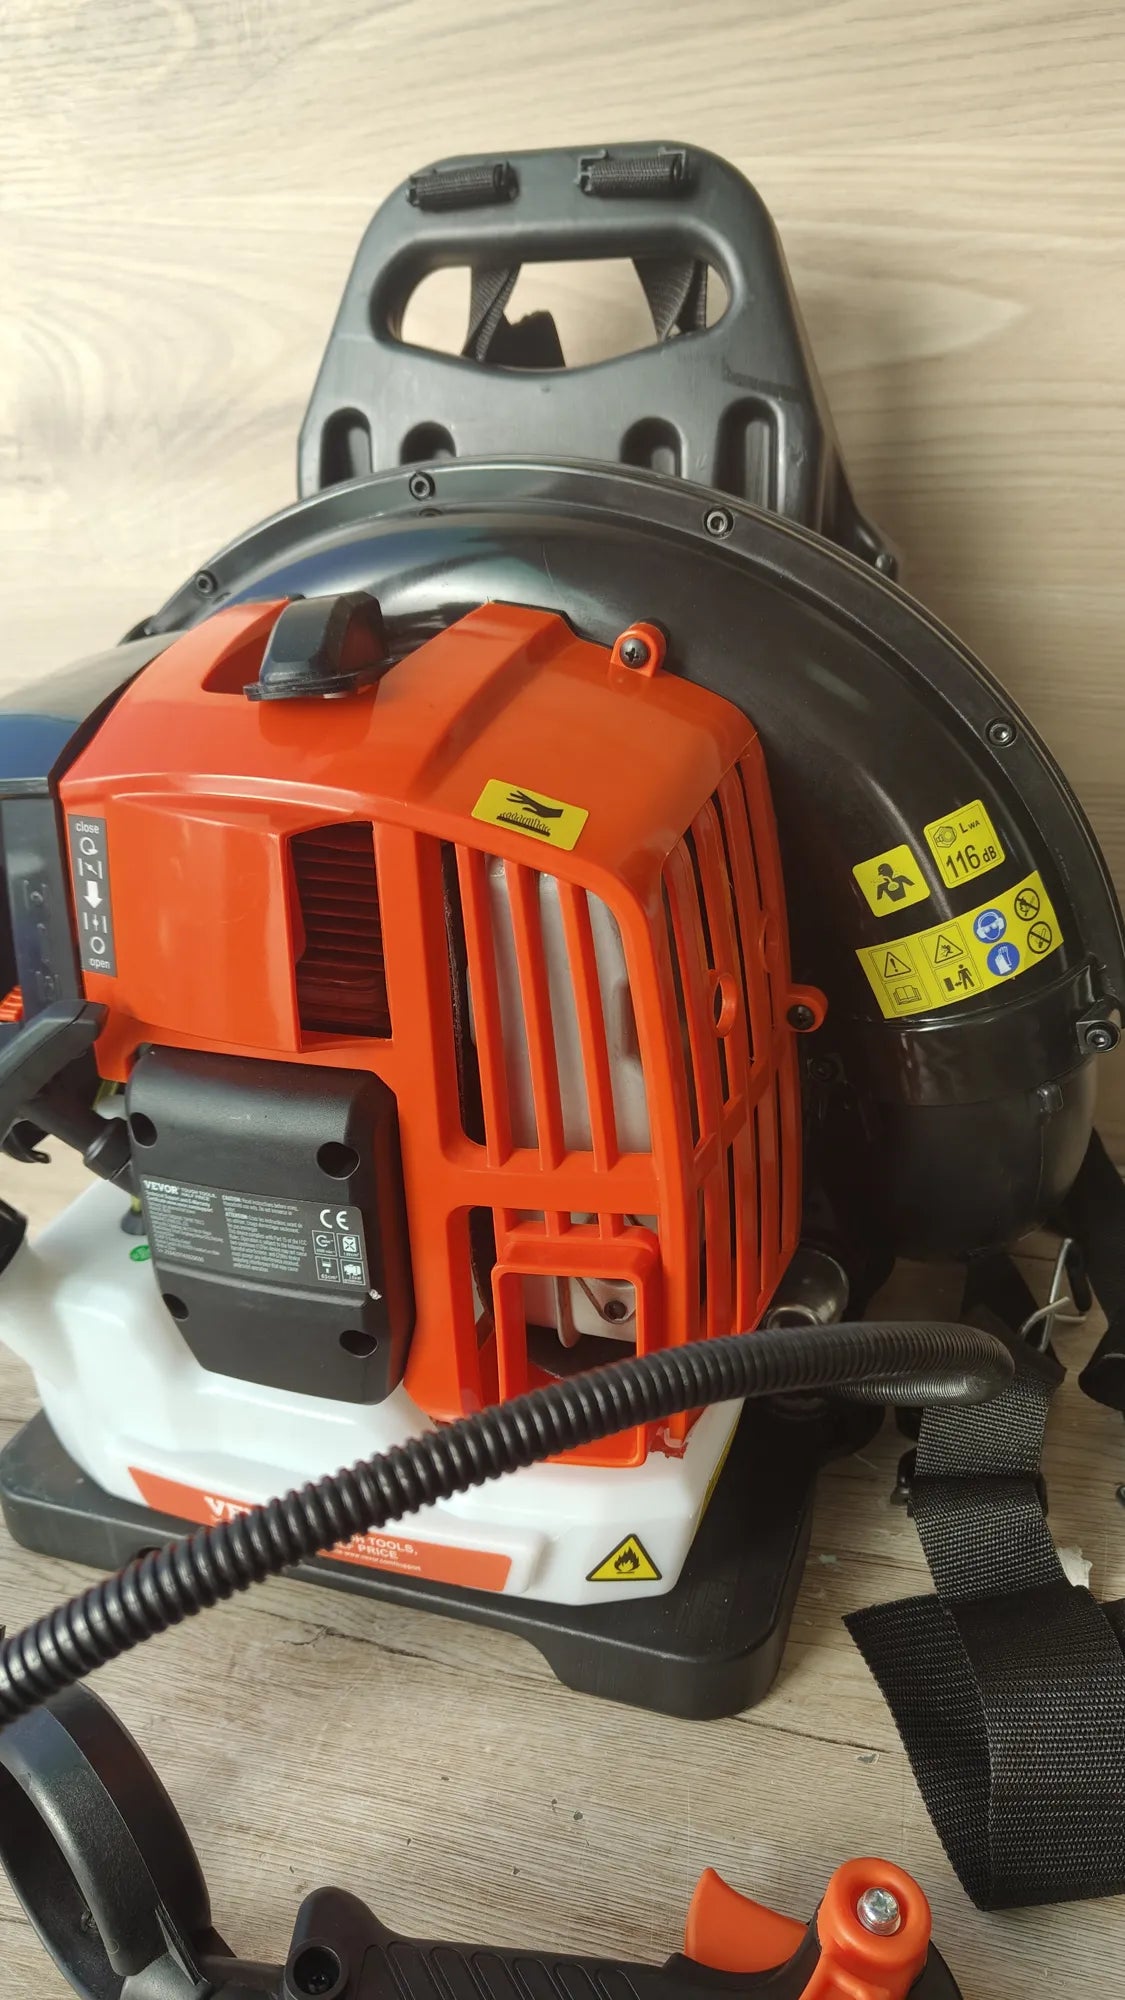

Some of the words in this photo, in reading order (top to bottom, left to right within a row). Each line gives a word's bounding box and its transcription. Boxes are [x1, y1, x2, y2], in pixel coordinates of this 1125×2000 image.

[76, 821, 100, 834] close
[946, 845, 981, 878] 116
[982, 845, 997, 863] dB
[89, 958, 111, 970] open
[143, 1179, 179, 1195] VEVOR
[319, 1208, 350, 1231] CE
[357, 1544, 399, 1559] PRICE
[368, 1536, 418, 1555] TOOLS,
